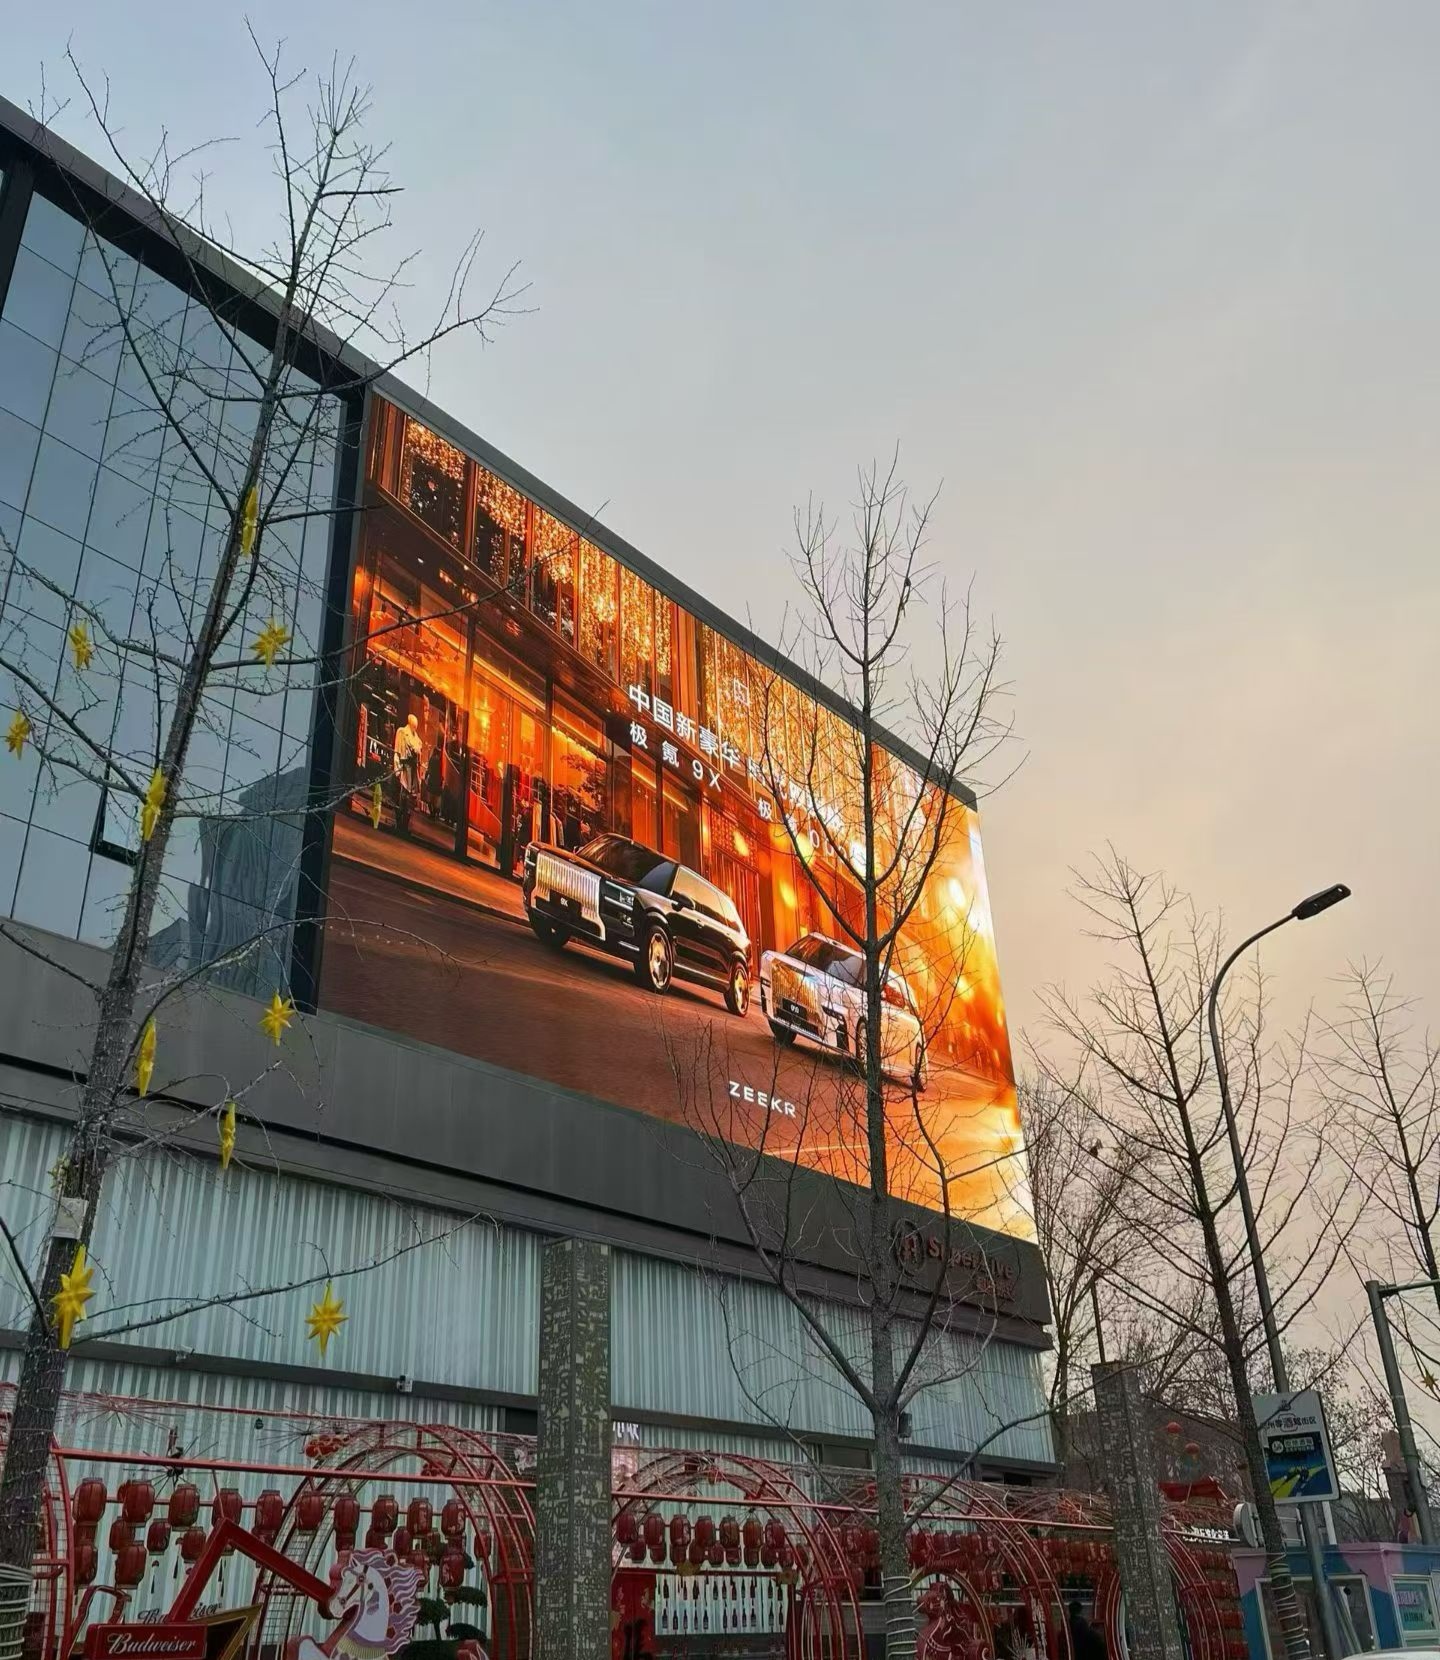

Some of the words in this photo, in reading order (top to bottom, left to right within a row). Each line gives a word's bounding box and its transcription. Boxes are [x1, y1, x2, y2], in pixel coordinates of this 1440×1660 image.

[629, 684, 741, 771] 中国新豪华
[728, 1081, 797, 1118] ZEEKR
[107, 1632, 197, 1655] Budweiser
